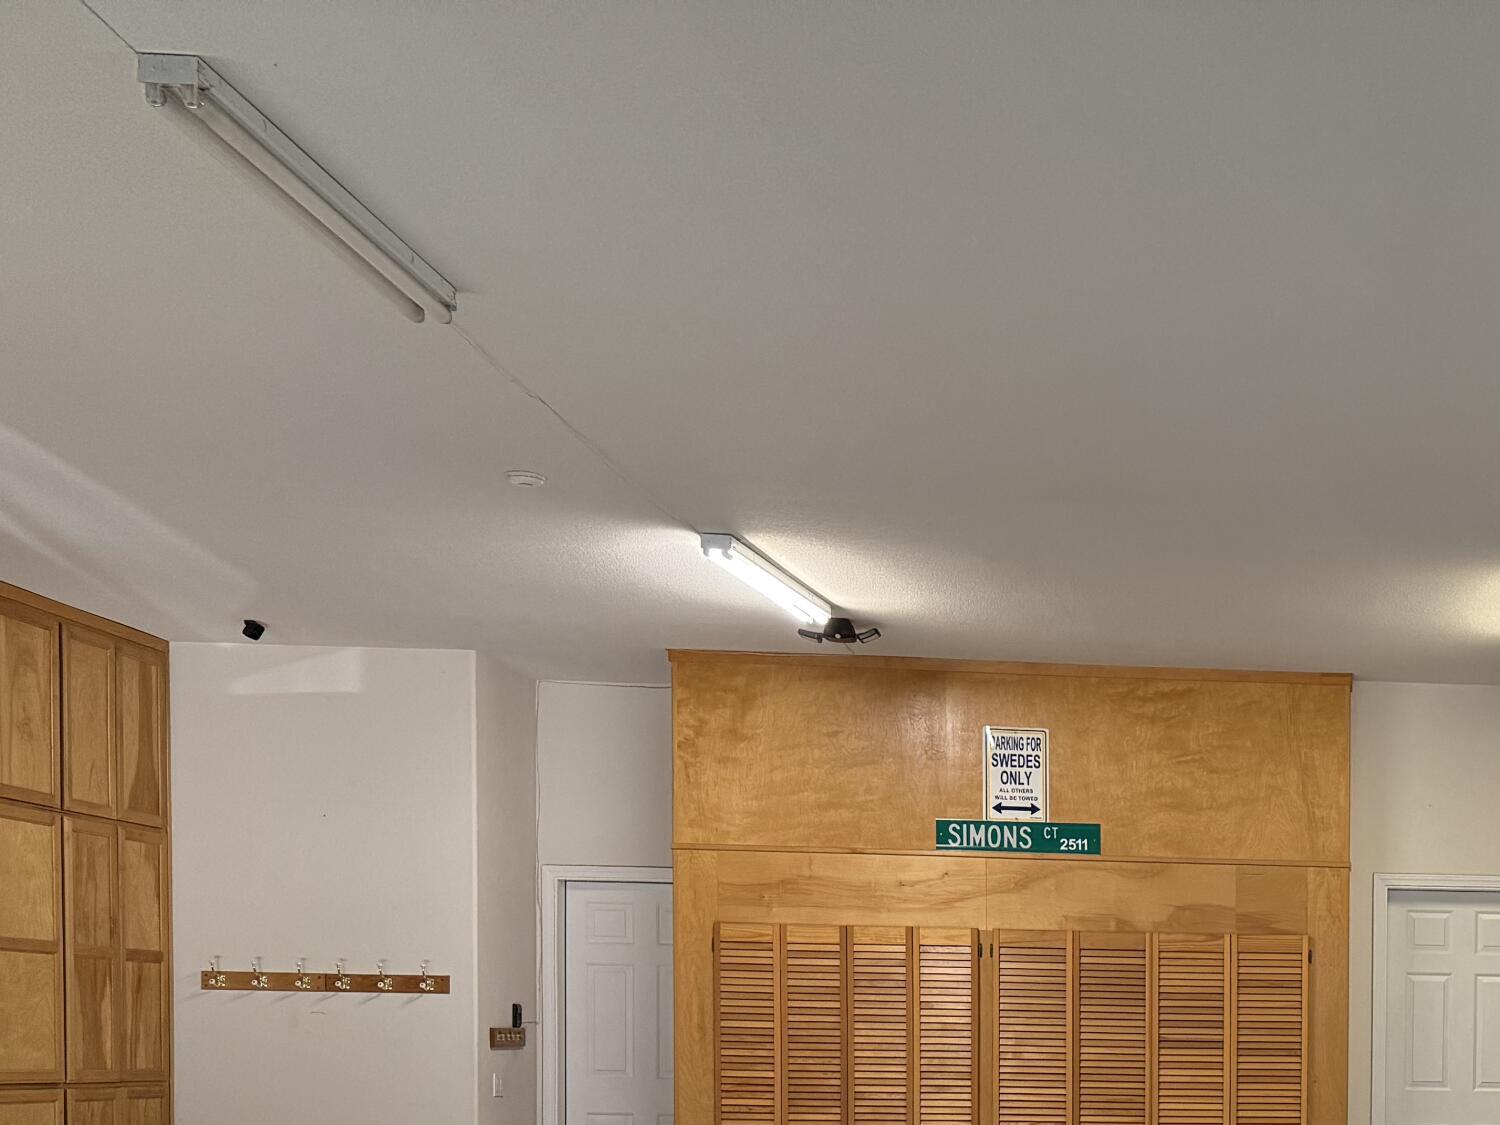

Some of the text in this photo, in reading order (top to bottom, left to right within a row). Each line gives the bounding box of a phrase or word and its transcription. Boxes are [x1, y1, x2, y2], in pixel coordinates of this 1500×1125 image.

[1026, 737, 1042, 751] FOR
[991, 753, 1041, 769] SWEDES
[1000, 770, 1032, 786] ONLY
[948, 823, 1088, 851] SIMONS CT 2511
